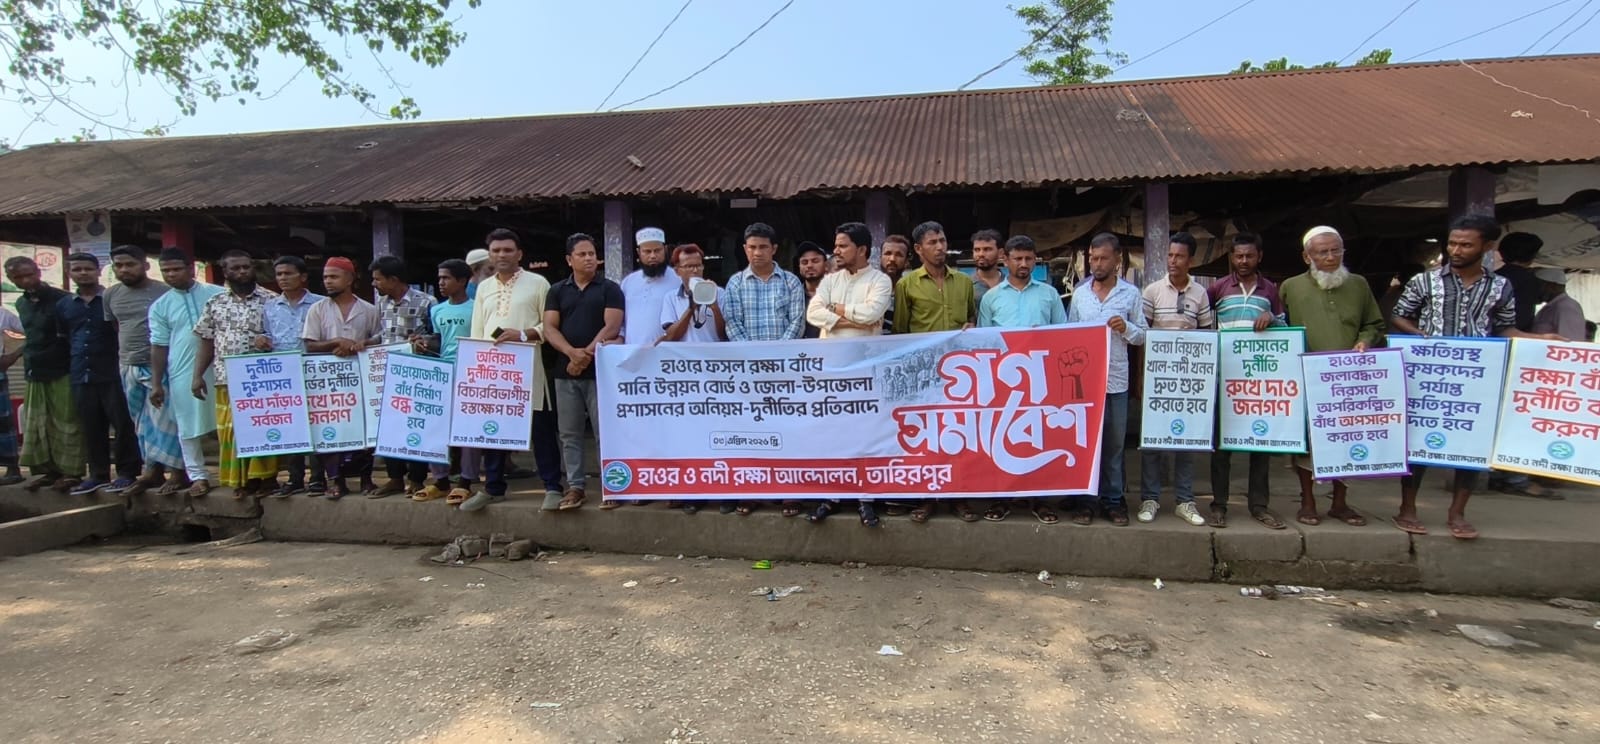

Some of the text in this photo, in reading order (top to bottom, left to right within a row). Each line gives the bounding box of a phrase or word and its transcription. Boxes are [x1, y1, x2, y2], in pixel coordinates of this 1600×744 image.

[1152, 337, 1212, 358] বন্যা নিয়ন্ত্রণে
[1232, 340, 1289, 354] প্রশাসনের
[476, 348, 516, 365] অনিয়ম
[660, 352, 824, 374] হাওরে ফসল রক্ষা বাঁধে
[1147, 356, 1214, 375] খাল-নদী খনন
[1242, 354, 1279, 377] দুর্নীতি
[1328, 354, 1376, 367] হাওরের
[319, 360, 352, 374] উন্নয়ন
[391, 364, 449, 385] অপ্রয়োজনীয়
[1320, 369, 1388, 382] জলাবদ্ধতা
[1405, 362, 1486, 379] কৃষকদের
[501, 370, 523, 384] বন্ধে
[940, 350, 1049, 406] গণ
[1154, 377, 1205, 395] দ্রুত শুরু
[1520, 367, 1575, 387] রক্ষা
[242, 378, 292, 397] দুঃশাসন
[395, 381, 412, 396] বাঁধ
[414, 383, 442, 401] নির্মাণ
[458, 382, 530, 403] বিচারবিভাগীয়
[618, 375, 873, 398] পানি উন্নয়ন বোর্ড ও জেলা-উপজেলা
[1225, 380, 1298, 397] রুখে দাও
[1331, 384, 1378, 397] নিরসনে
[1419, 378, 1464, 396] পর্যাপ্ত
[235, 393, 302, 412] রুখে দাঁড়াও
[330, 393, 357, 407] দাও
[391, 396, 412, 414] বন্ধ
[414, 402, 444, 416] করতে
[617, 402, 685, 418] প্রশাসনের
[811, 396, 879, 417] প্রতিবাদে
[1149, 397, 1208, 415] করতে হবে
[1233, 399, 1290, 416] জনগণ
[1316, 396, 1396, 412] অপরিকল্পিত
[1513, 387, 1583, 414] দুর্নীতি
[250, 410, 292, 426] সর্বজন
[460, 402, 525, 417] হস্তক্ষেপ চাই
[407, 416, 425, 429] হবে
[1312, 414, 1402, 428] বাঁধ অপসারণ
[1442, 418, 1474, 431] হবে
[1532, 417, 1600, 440] করুন
[898, 390, 1094, 475] সমাবেশ
[1327, 430, 1388, 443] করতে হবে
[637, 459, 952, 490] হাওর ও নদী রক্ষা আন্দোলন, তাহিরপুর
